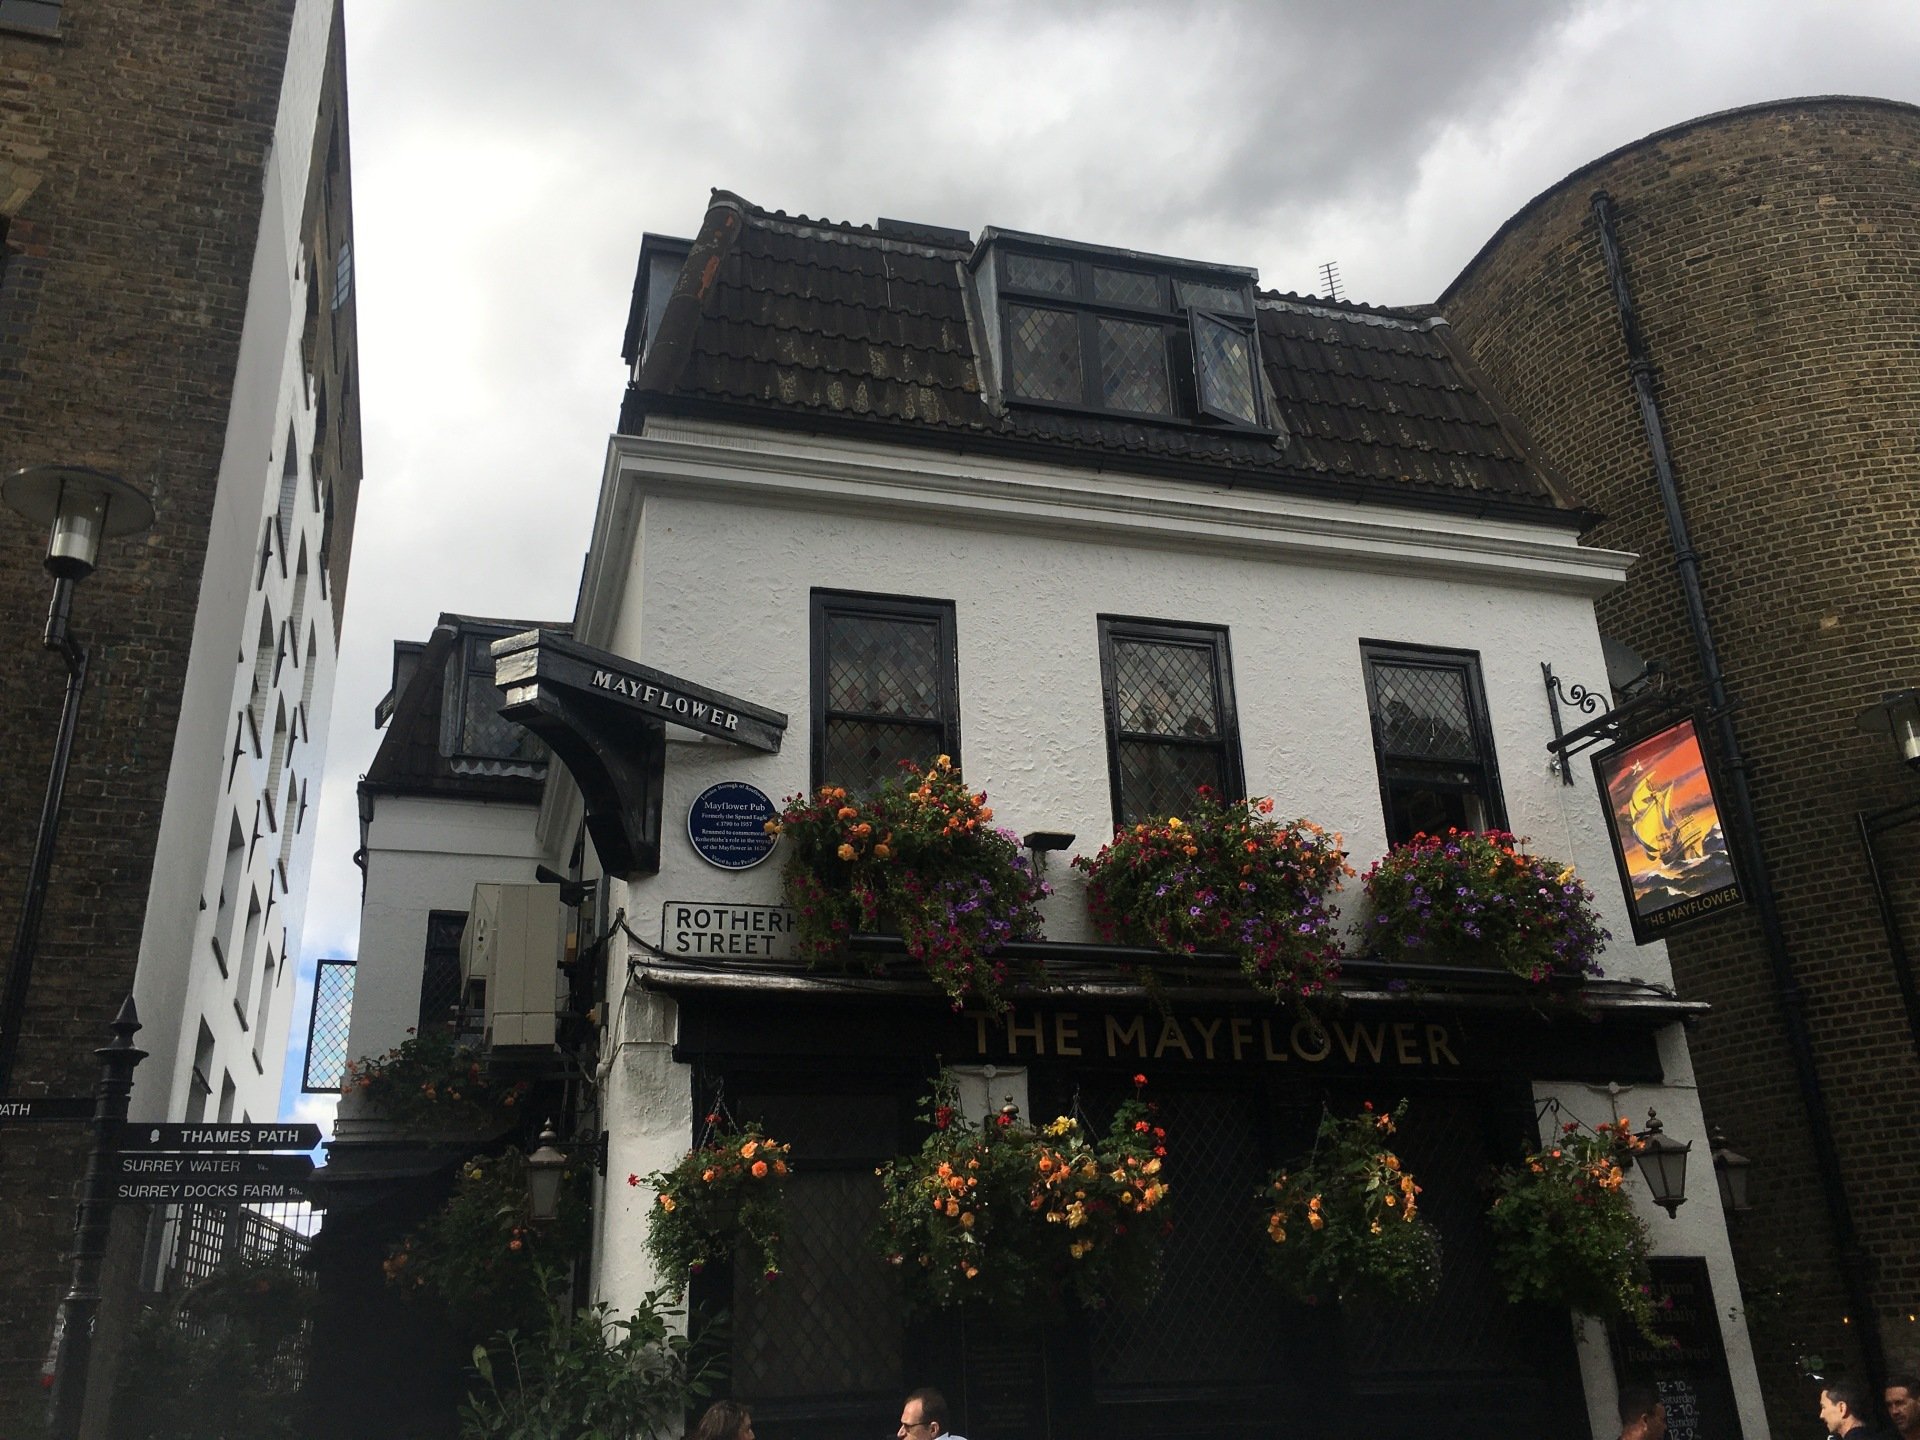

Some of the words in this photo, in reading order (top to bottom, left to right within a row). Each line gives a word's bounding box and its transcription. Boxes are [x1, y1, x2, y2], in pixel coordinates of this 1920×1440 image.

[592, 670, 739, 731] MAYFLOWER
[704, 802, 748, 811] Mayflower
[750, 803, 766, 811] Pub
[1666, 888, 1740, 923] MAYFLOWER
[676, 932, 776, 955] STREET
[965, 1010, 1082, 1055] THE
[1105, 1015, 1460, 1065] MAYFLOWER
[0, 1103, 31, 1116] ATH
[180, 1130, 251, 1143] THAMES
[258, 1130, 299, 1143] PATH
[122, 1159, 184, 1172] SURREY
[190, 1160, 240, 1172] WATER
[118, 1184, 180, 1198] SURREY
[183, 1184, 238, 1198] DOCKS
[243, 1184, 284, 1197] FARM
[1667, 1416, 1698, 1428] Sunday
